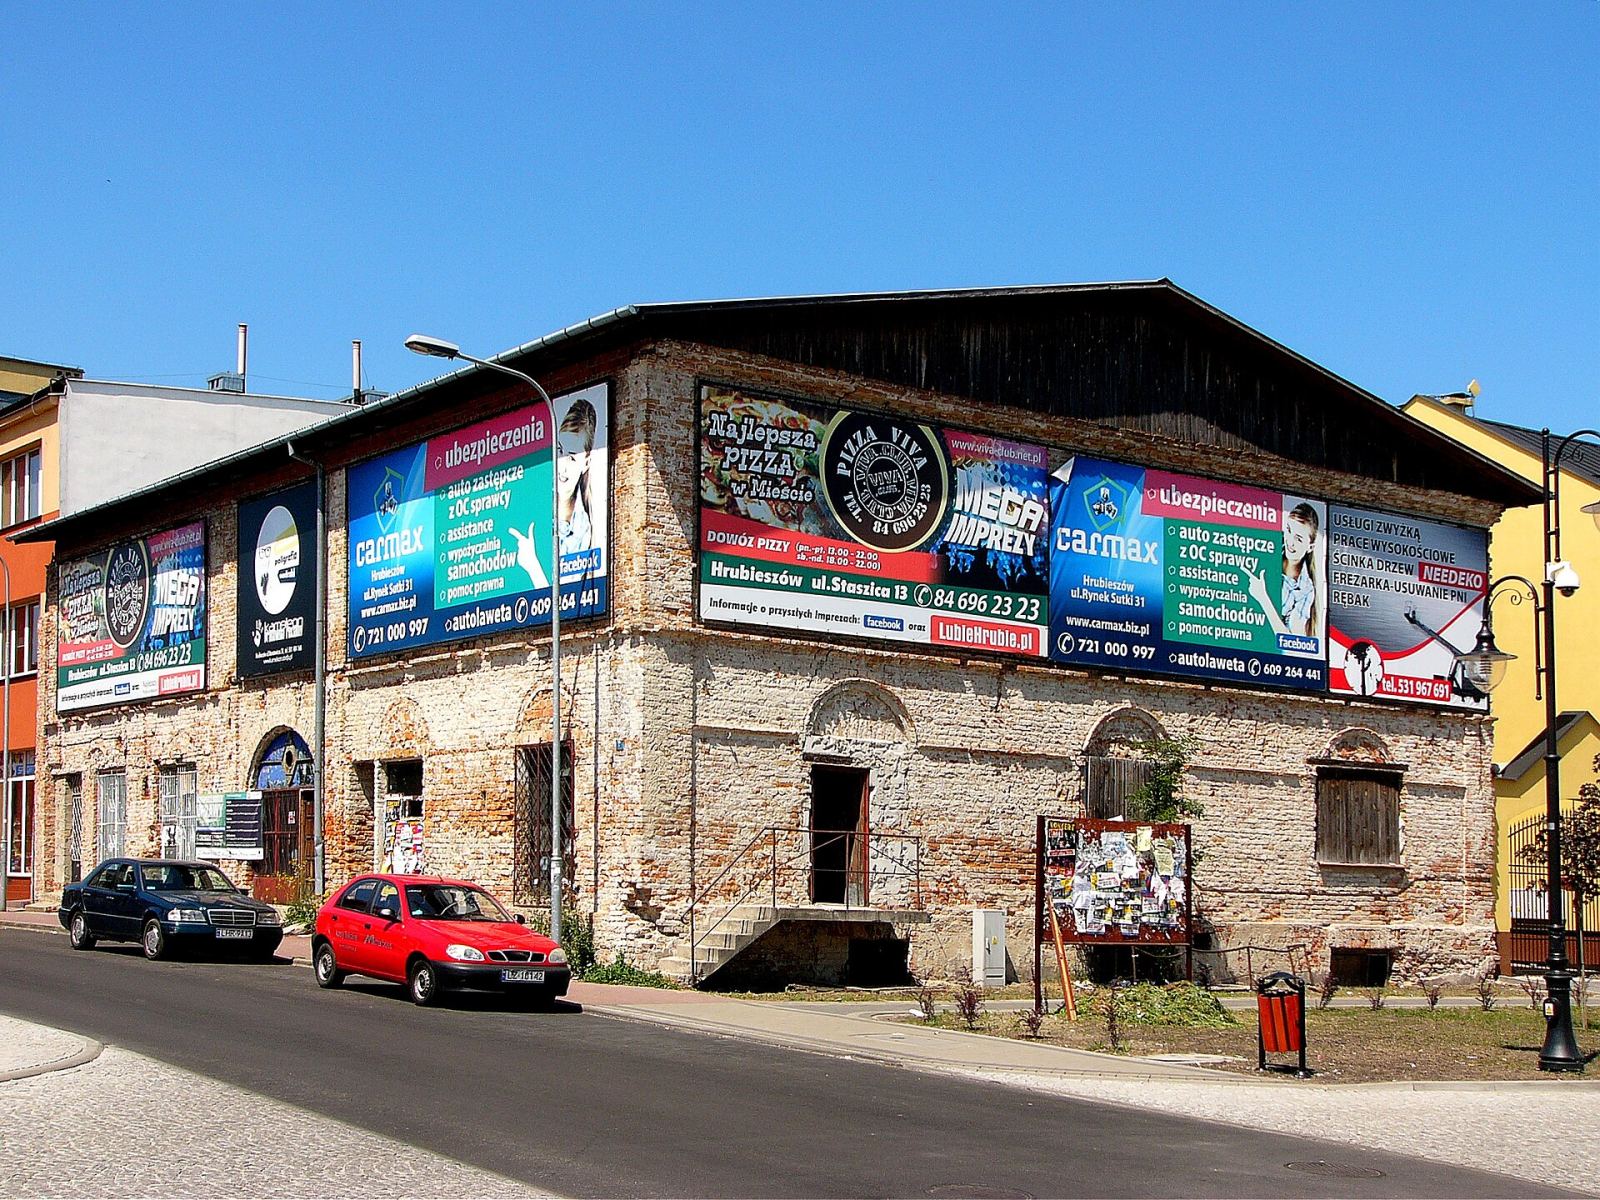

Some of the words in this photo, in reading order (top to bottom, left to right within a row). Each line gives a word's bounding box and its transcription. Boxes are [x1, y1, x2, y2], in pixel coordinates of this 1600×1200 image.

[446, 416, 544, 468] ubezpieczenia
[709, 413, 816, 450] Najlepsza
[836, 425, 878, 477] PIZZA
[891, 426, 928, 470] VIVA
[951, 440, 1042, 464] www.viva-club.net.pl
[448, 480, 472, 499] auto
[472, 465, 524, 491] zastępcze
[731, 482, 746, 495] w
[750, 479, 813, 502] Mieście
[868, 469, 903, 487] VIVA
[449, 505, 454, 520] z
[456, 498, 470, 517] OC
[471, 490, 511, 517] sprawcy
[920, 483, 932, 502] 23
[955, 467, 1044, 532] MEGA
[1160, 484, 1276, 523] ubezpieczenia
[843, 491, 862, 522] TEL.
[913, 502, 928, 520] 23
[447, 518, 494, 542] assistance
[872, 520, 889, 535] 84
[892, 516, 916, 534] 696
[943, 513, 1036, 556] IMPREZY
[1334, 514, 1374, 532] USŁUGI
[1376, 520, 1421, 543] ZWYŻKĄ
[355, 525, 424, 567] carmax
[448, 536, 501, 562] wypożyczalnia
[707, 530, 754, 548] DOWÓZ
[758, 538, 790, 553] PIZZY
[856, 550, 878, 560] 22.00
[1056, 527, 1158, 565] carmax
[1180, 526, 1210, 542] auto
[1212, 532, 1274, 554] zastępcze
[1334, 534, 1368, 550] PRACE
[1371, 539, 1456, 564] WYSOKOŚCIOWE
[448, 550, 516, 581] samochodów
[560, 553, 598, 574] facebook
[856, 560, 880, 571] 22.00)
[1180, 546, 1186, 558] z
[1189, 544, 1206, 561] OC
[1209, 550, 1258, 572] sprawcy
[1334, 550, 1374, 570] ŚCINKA
[1376, 559, 1414, 576] DRZEW
[1083, 575, 1134, 592] Hrubieszów
[1179, 565, 1239, 585] assistance
[1334, 572, 1448, 600] FREZARKA-USUWANIE
[1450, 590, 1468, 604] PNI
[1423, 565, 1484, 588] NEEDEKO
[155, 570, 200, 607] MEGA
[448, 582, 473, 603] pomoc
[474, 577, 504, 596] prawna
[711, 561, 803, 587] Hrubieszów
[812, 575, 890, 598] ul.Staszica
[894, 585, 908, 600] 13
[934, 589, 954, 608] 84
[958, 592, 988, 612] 696
[990, 596, 1012, 616] 23
[1014, 598, 1040, 621] 23
[1070, 588, 1110, 603] ul.Rynek
[1110, 593, 1134, 606] Sutki
[1135, 596, 1145, 608] 31
[1179, 584, 1248, 603] wypożyczalnia
[1334, 590, 1370, 608] RĘBAK
[152, 607, 196, 636] IMPREZY
[452, 604, 512, 631] autolaweta
[531, 598, 551, 616] 609
[580, 588, 598, 607] 441
[769, 606, 812, 620] przyszłych
[866, 616, 901, 630] facebook
[908, 623, 926, 632] oraz
[1179, 602, 1266, 626] samochodów
[368, 627, 384, 645] 721
[388, 622, 406, 641] 000
[409, 618, 428, 637] 997
[1066, 616, 1150, 637] www.carmax.biz.pl
[1179, 622, 1213, 636] pomoc
[1214, 626, 1252, 641] prawna
[144, 652, 153, 670] 84
[154, 649, 167, 667] 696
[168, 646, 178, 665] 23
[180, 643, 191, 664] 23
[1278, 635, 1316, 652] facebook
[1078, 638, 1099, 653] 721
[1104, 642, 1128, 656] 000
[1132, 645, 1156, 660] 997
[1178, 652, 1245, 673] autolaweta
[1264, 664, 1282, 676] 609
[1285, 666, 1302, 679] 264
[1306, 668, 1321, 680] 441
[1382, 676, 1397, 692] tel.
[1398, 680, 1414, 695] 531
[1416, 682, 1432, 697] 967
[1434, 684, 1450, 698] 691
